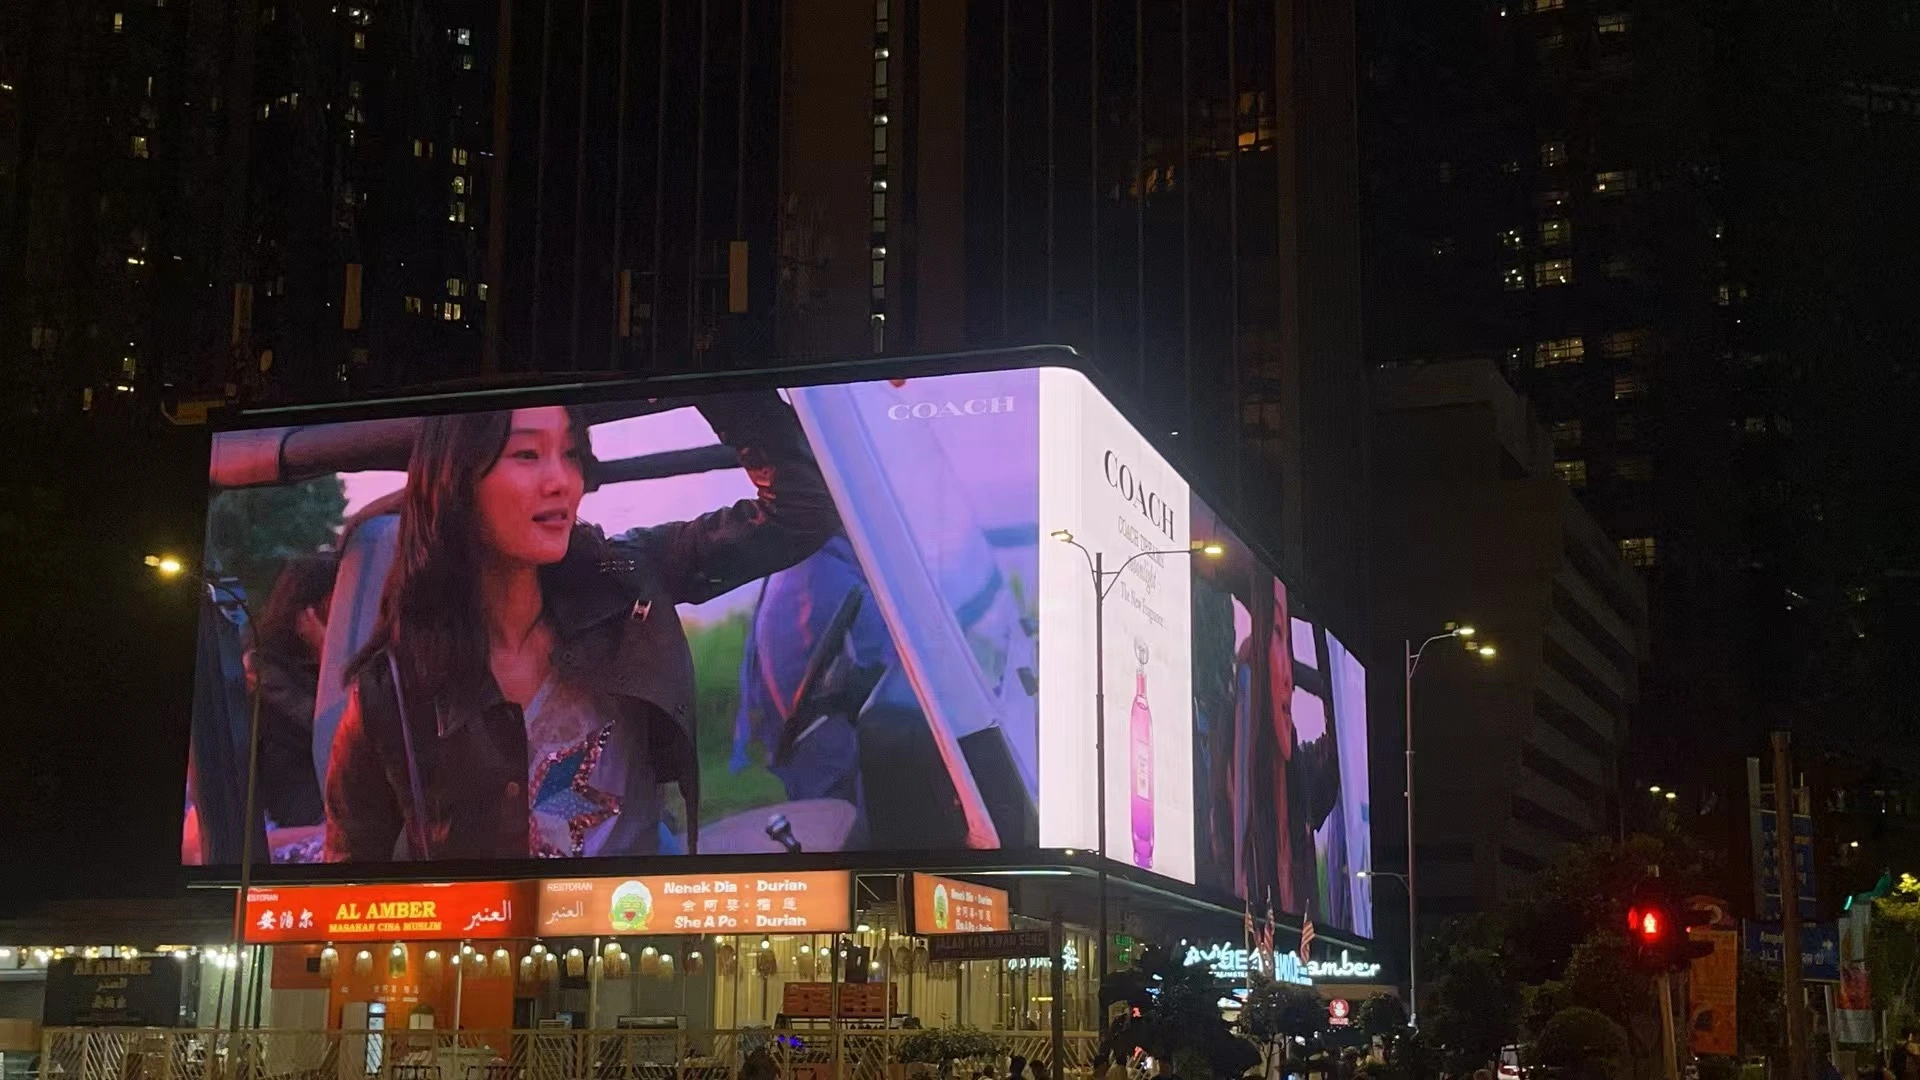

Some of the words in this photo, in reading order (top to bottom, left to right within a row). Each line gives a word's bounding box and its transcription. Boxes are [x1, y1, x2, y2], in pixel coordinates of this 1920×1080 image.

[888, 396, 1016, 420] COACH
[1104, 450, 1175, 542] COACH
[547, 882, 592, 892] RESTORAN
[664, 882, 711, 895] Nenek
[714, 881, 738, 894] Dia
[757, 880, 807, 892] Durian
[246, 893, 279, 903] ESTORAN
[336, 904, 360, 920] AL
[366, 901, 436, 919] AMBER
[464, 900, 512, 931] العنبر
[675, 915, 702, 929] She
[703, 915, 715, 928] A
[718, 915, 737, 928] Po
[756, 914, 807, 928] Durian
